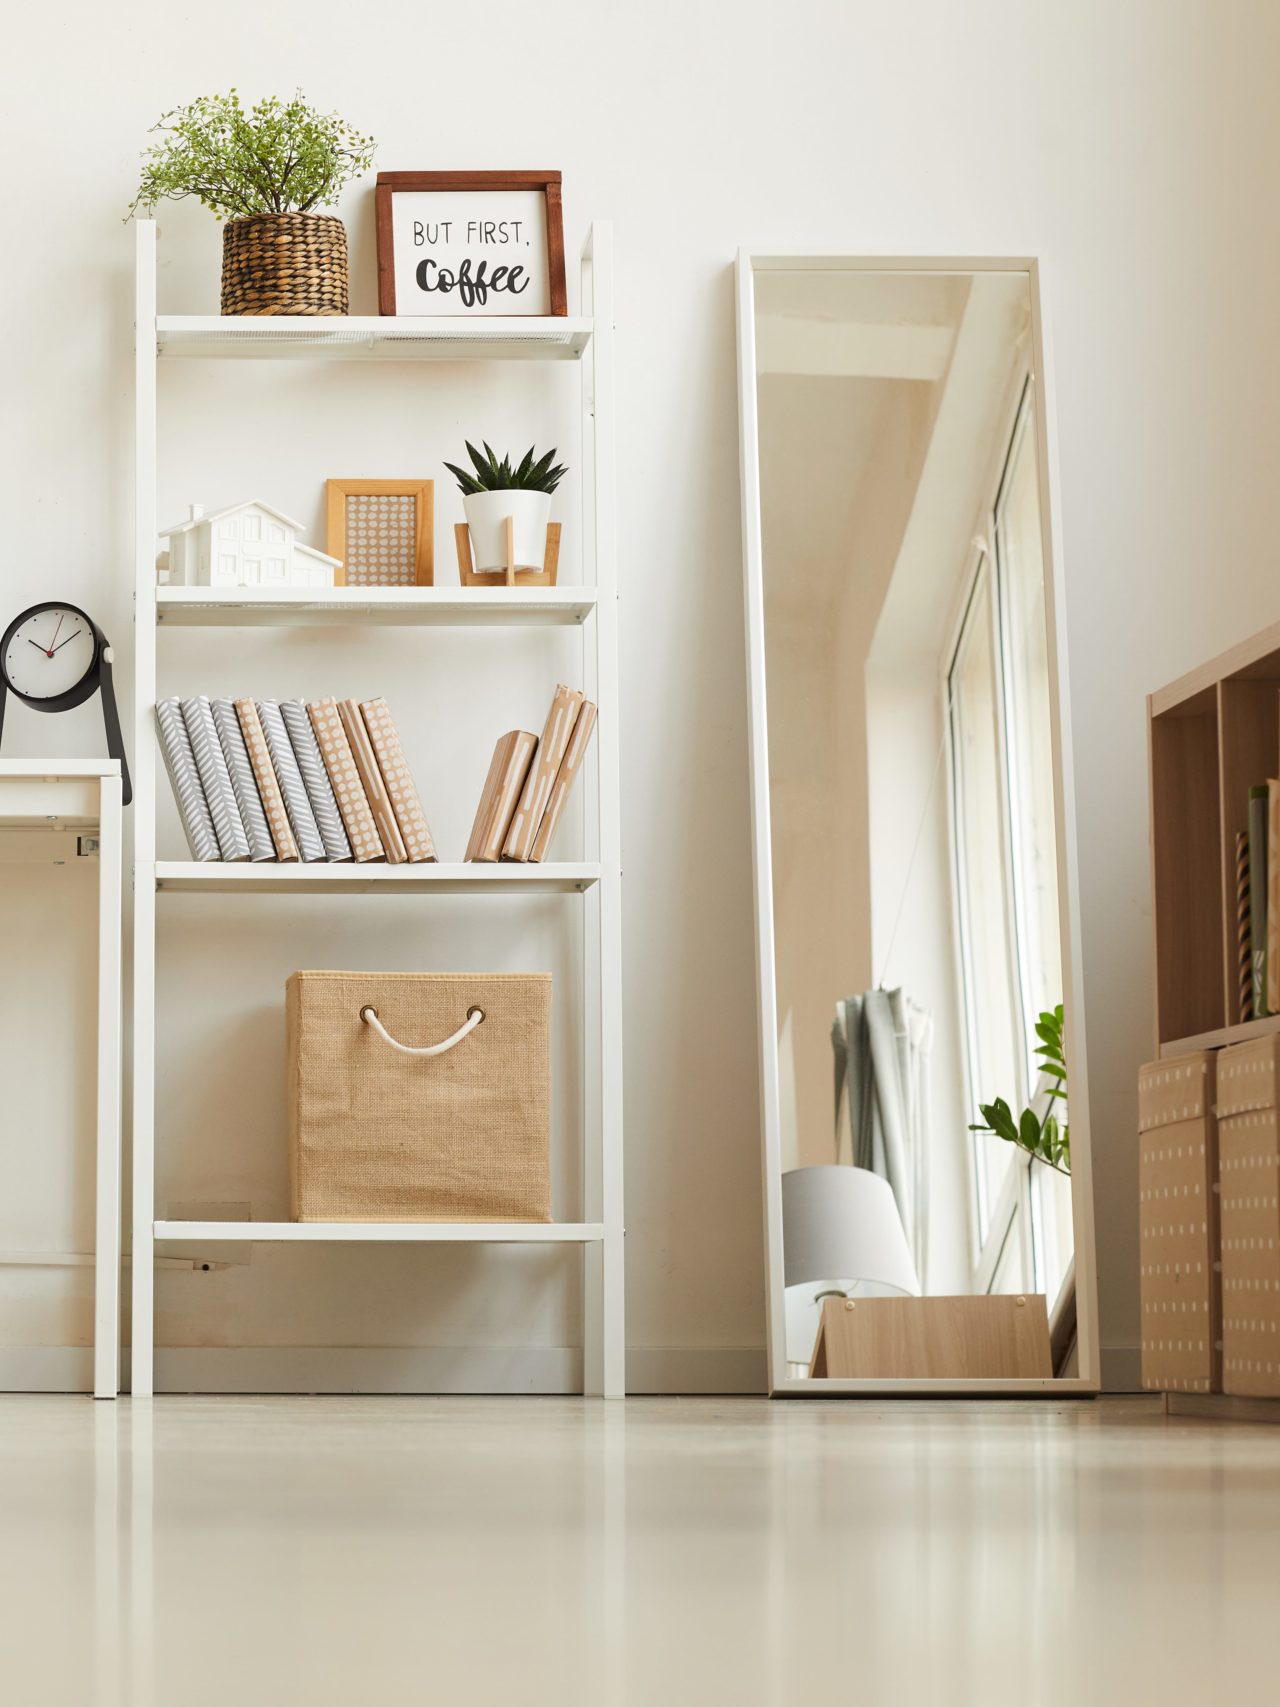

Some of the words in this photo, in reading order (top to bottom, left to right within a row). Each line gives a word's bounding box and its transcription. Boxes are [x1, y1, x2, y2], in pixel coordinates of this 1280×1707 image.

[413, 220, 453, 247] BUT
[467, 221, 530, 247] FIRST,
[415, 258, 531, 308] Coffee
